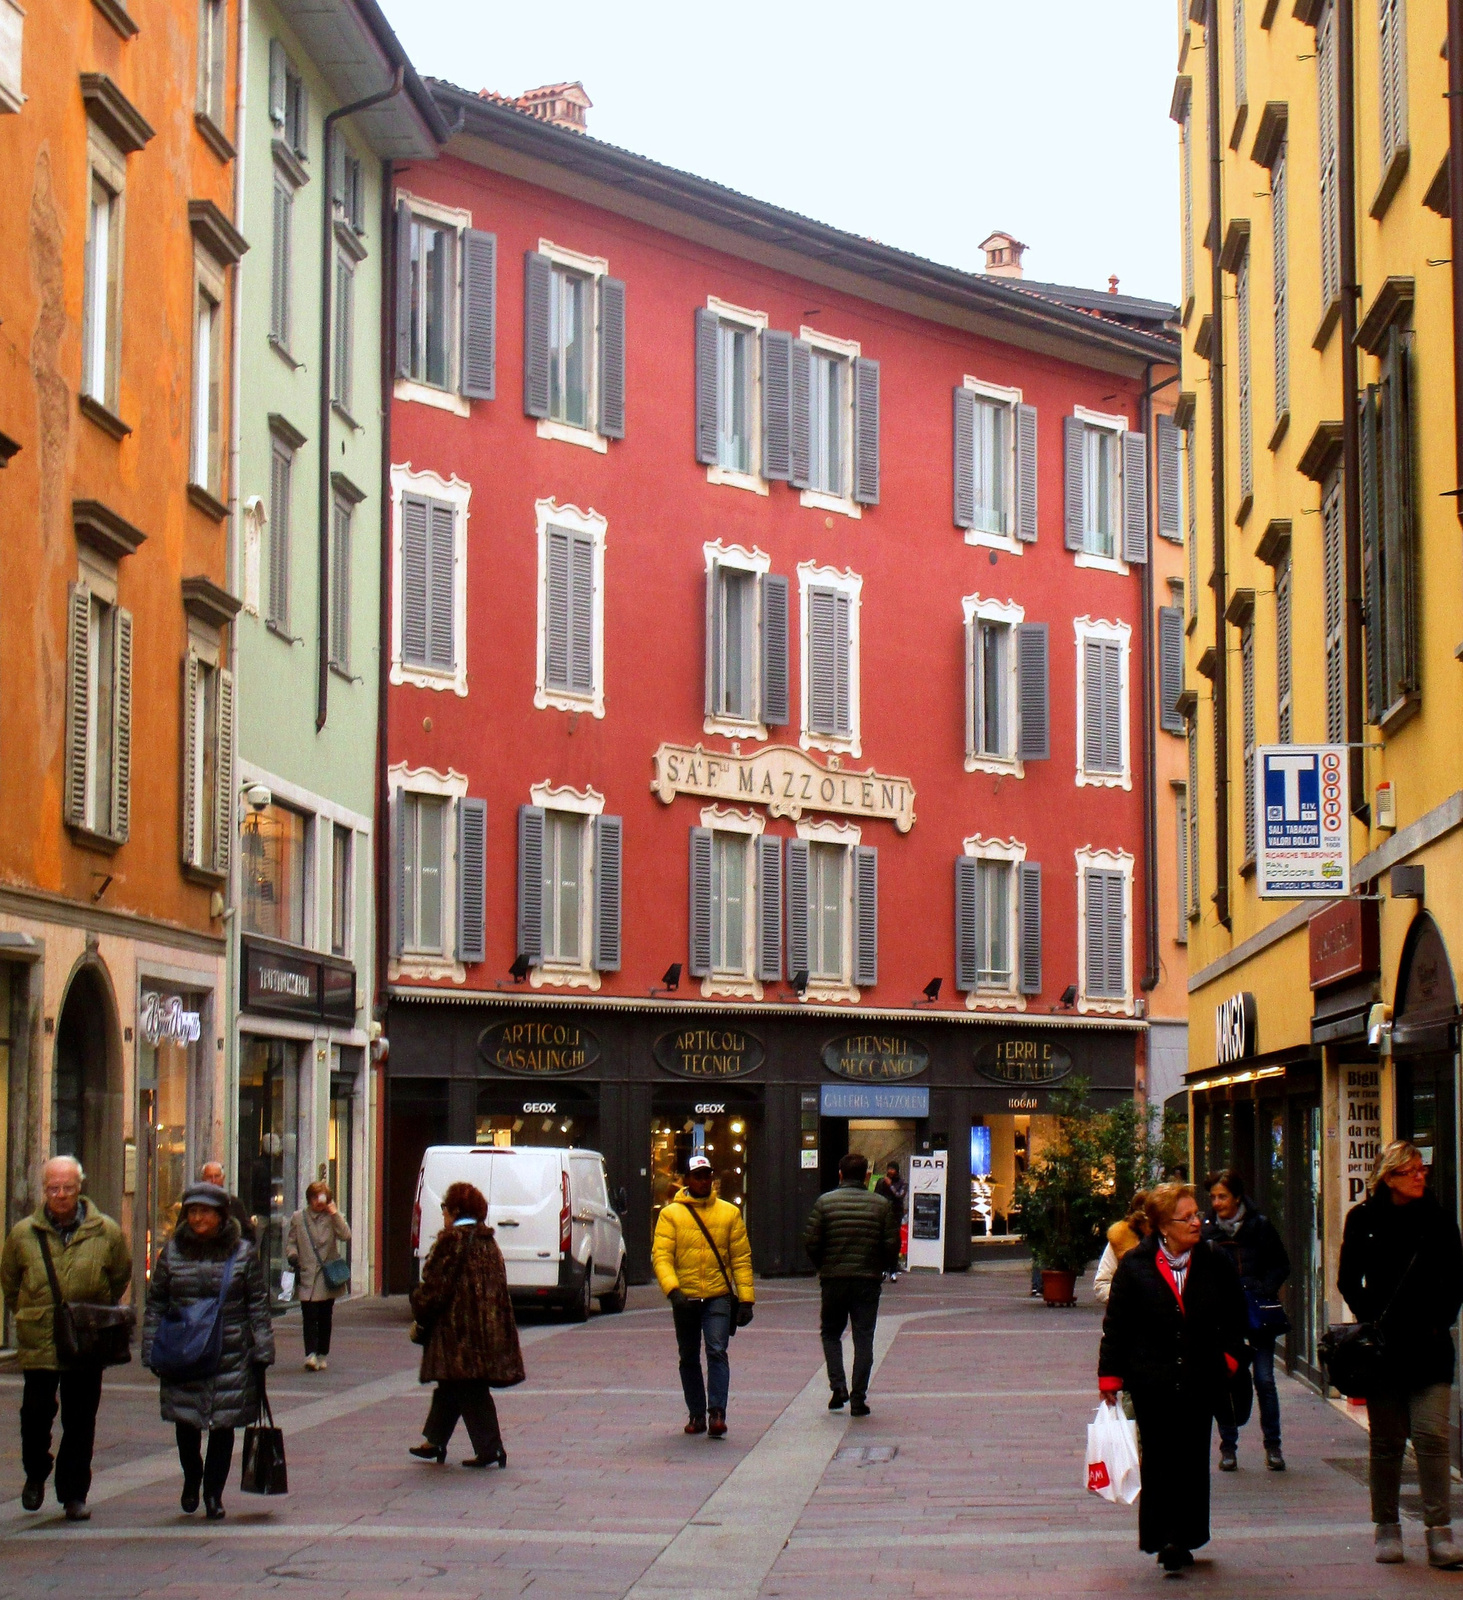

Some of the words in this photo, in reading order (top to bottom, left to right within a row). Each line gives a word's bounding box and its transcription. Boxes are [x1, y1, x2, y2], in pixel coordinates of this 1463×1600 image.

[738, 765, 906, 812] MAZZOLENI
[1268, 756, 1315, 821] T
[1268, 825, 1284, 834] SALI
[1286, 825, 1318, 834] TABACCHI
[1268, 837, 1291, 846] VALORI
[1293, 837, 1319, 846] BOLLATI
[502, 1023, 580, 1047] ARTICOLI
[675, 1030, 745, 1052] ARTICOLI
[846, 1035, 907, 1056] UTENSILI
[997, 1040, 1037, 1060] FERRI
[1043, 1043, 1052, 1060] E
[496, 1048, 585, 1071] CASALINGHI
[681, 1053, 741, 1074] TECNICI
[840, 1058, 914, 1078] MECCANICI
[523, 1102, 557, 1114] GEOX
[694, 1103, 726, 1114] GEOX
[824, 1093, 870, 1109] GALLERIA
[875, 1095, 926, 1109] MAZZOLENI
[1008, 1098, 1038, 1109] HOGAN
[1348, 1125, 1361, 1137] da
[912, 1159, 944, 1169] BAR
[1348, 1163, 1361, 1173] per
